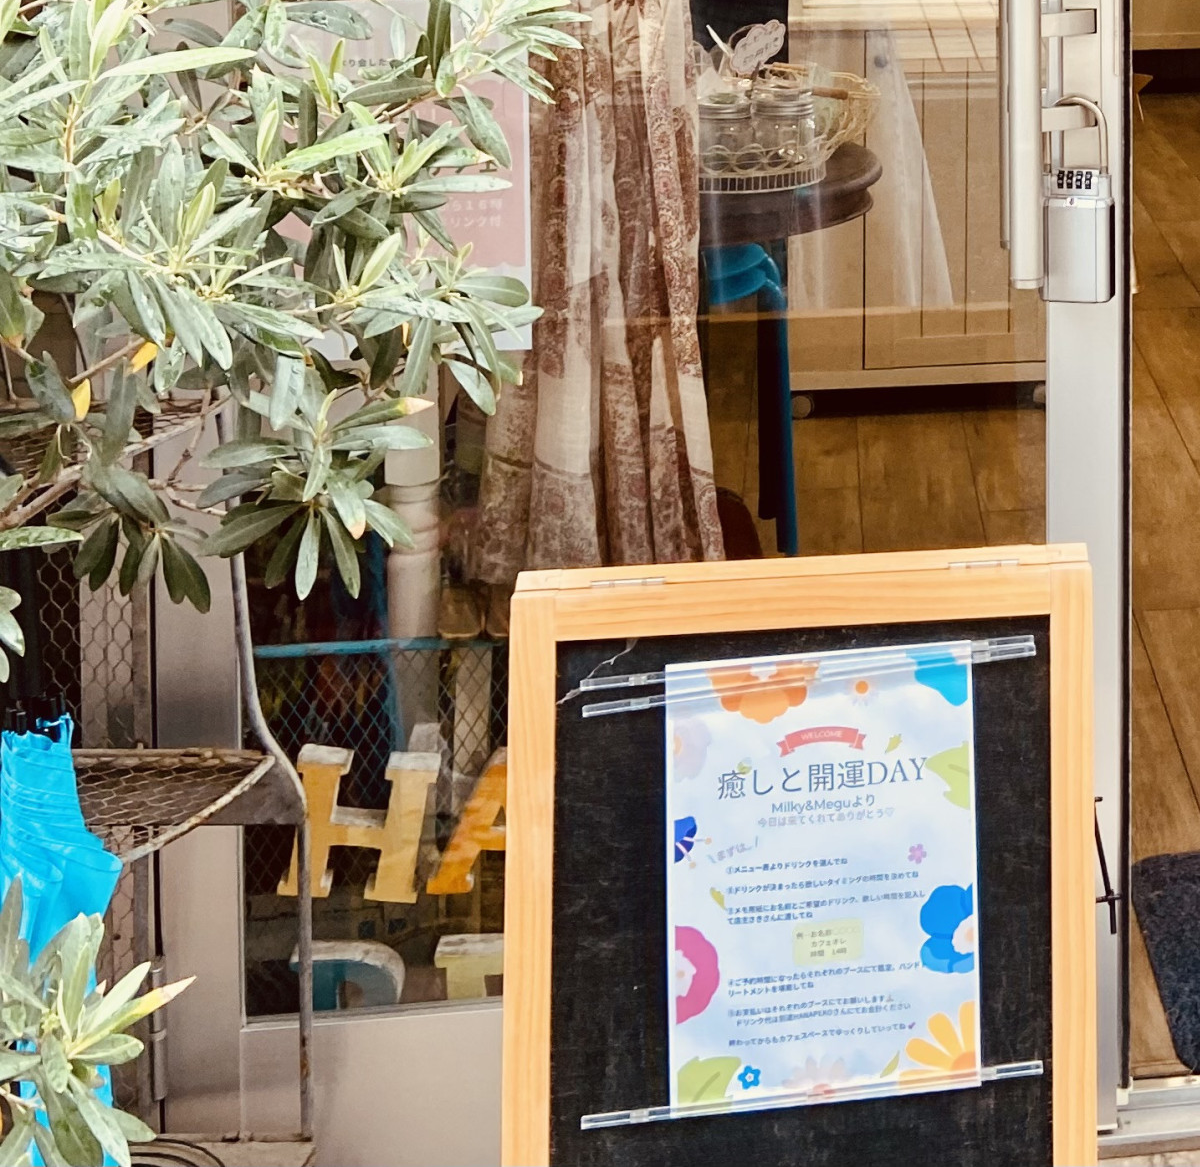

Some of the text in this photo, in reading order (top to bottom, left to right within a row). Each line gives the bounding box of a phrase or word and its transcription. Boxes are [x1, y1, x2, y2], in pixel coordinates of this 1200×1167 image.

[800, 728, 843, 741] WELCOME
[717, 756, 928, 801] 癒しと開運DAY
[771, 793, 876, 816] Milky&Meguより
